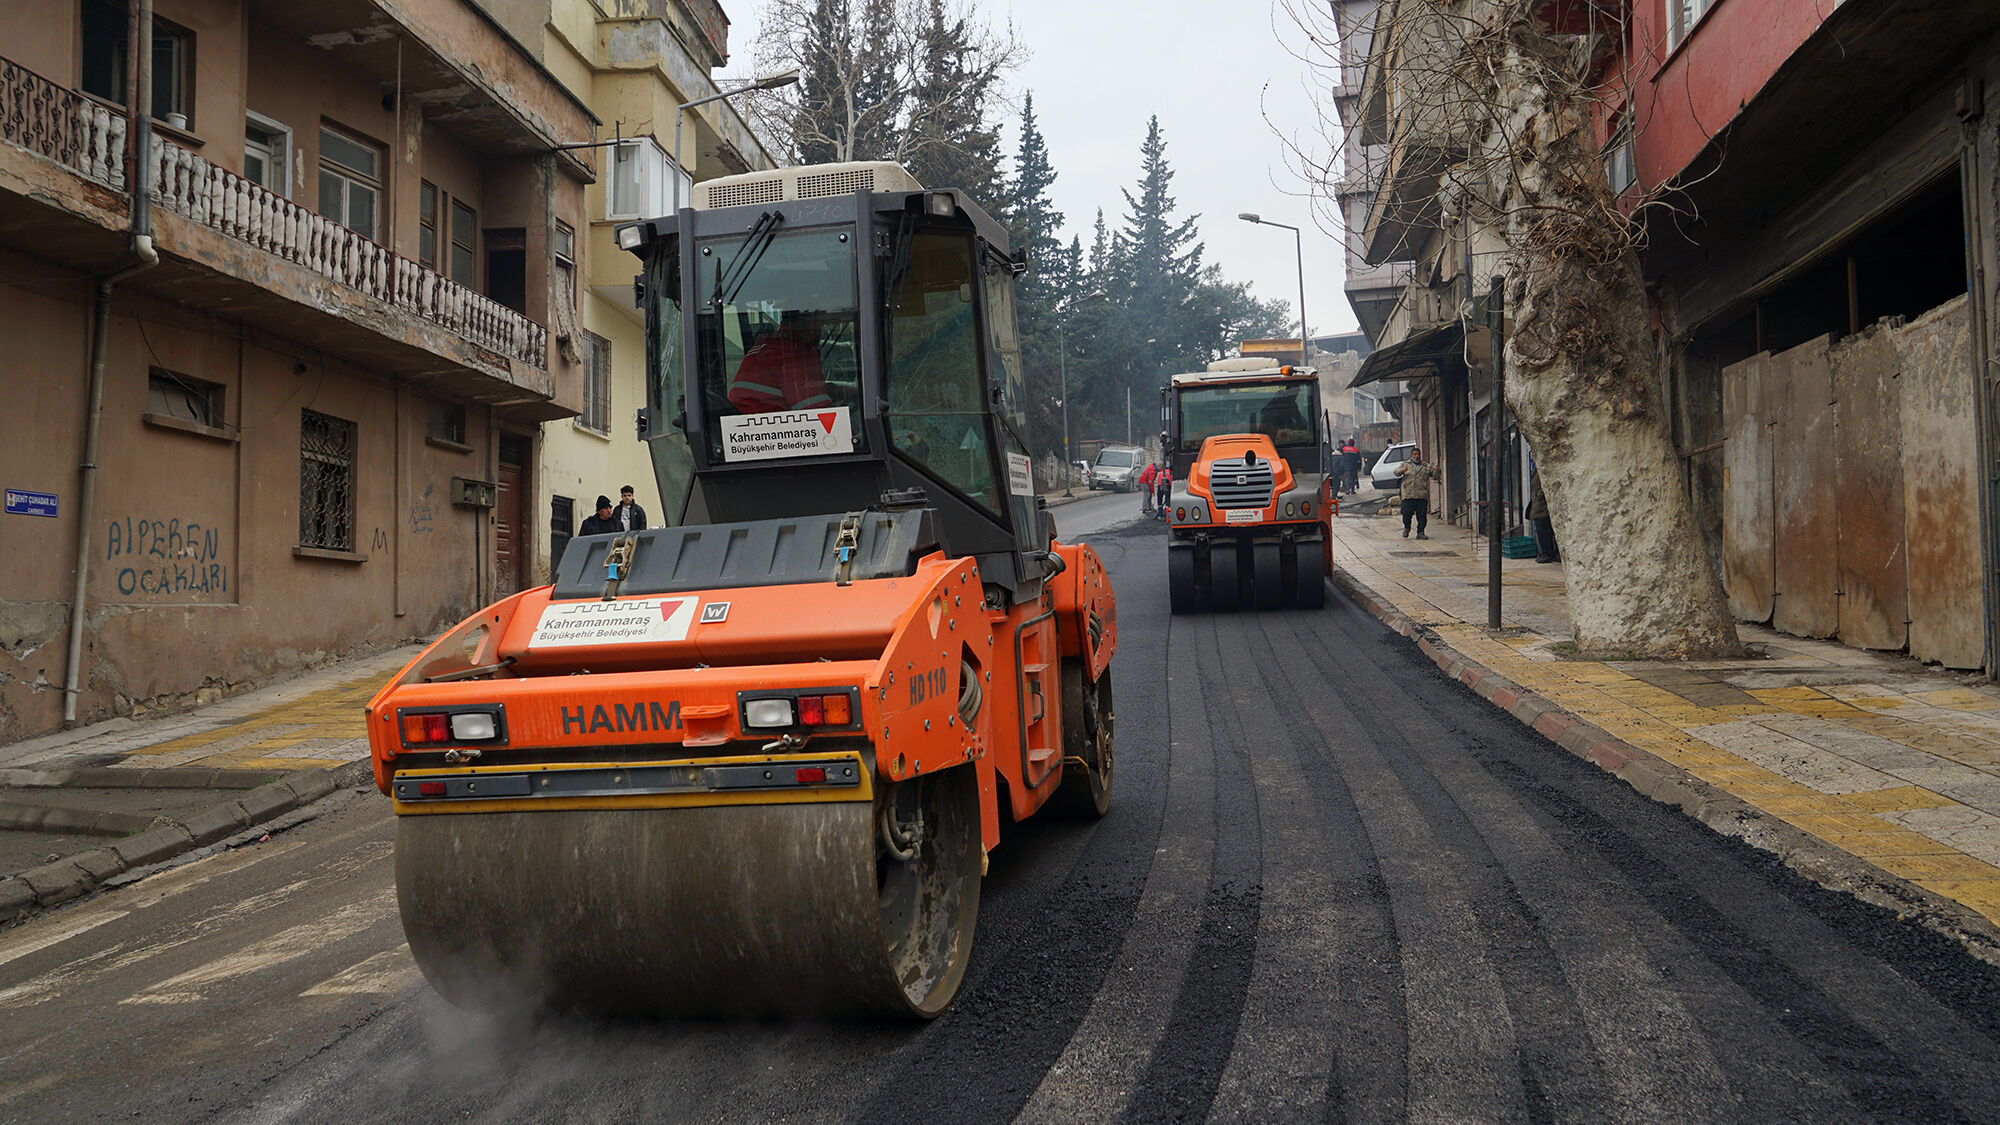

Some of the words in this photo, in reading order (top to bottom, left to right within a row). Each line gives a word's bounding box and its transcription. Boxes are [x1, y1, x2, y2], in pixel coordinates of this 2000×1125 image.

[729, 428, 817, 443] Kahramanmaraş
[731, 443, 775, 454] Büyükşehir
[777, 440, 819, 450] Belediyesi
[118, 563, 227, 595] OCAKLARI
[544, 616, 651, 630] Kahramanmaraş
[539, 630, 593, 640] Büyükşehir
[596, 628, 647, 638] Belediyesi
[910, 673, 925, 706] HD
[927, 666, 946, 699] 110
[561, 701, 683, 735] HAMM
